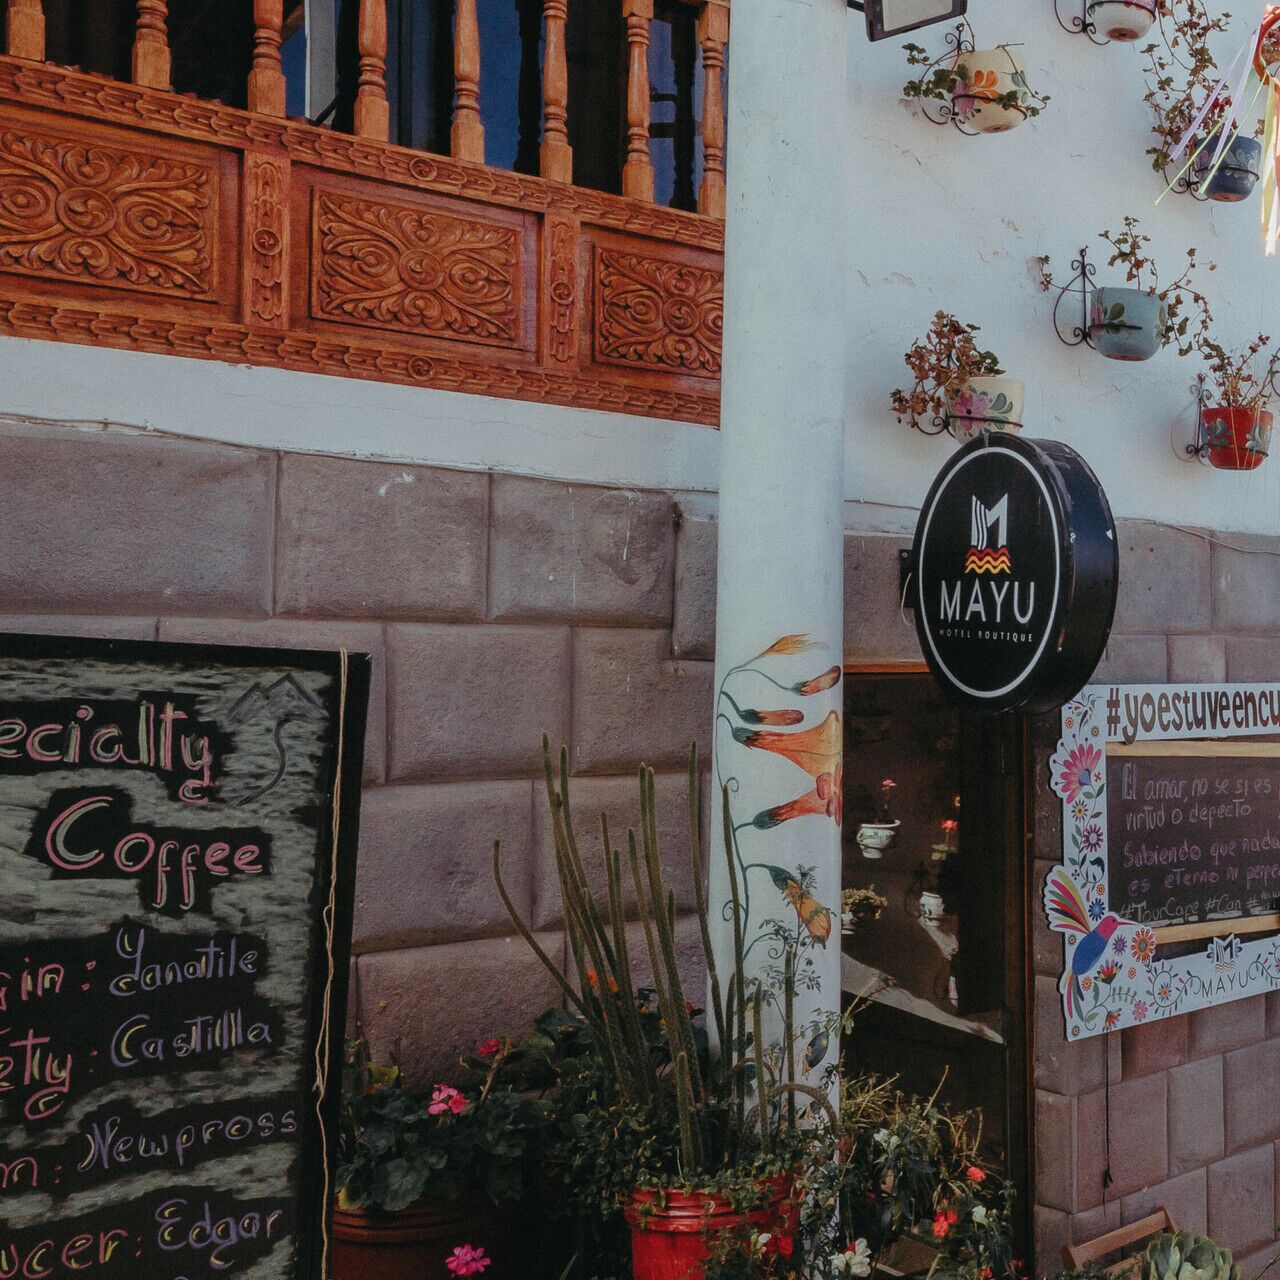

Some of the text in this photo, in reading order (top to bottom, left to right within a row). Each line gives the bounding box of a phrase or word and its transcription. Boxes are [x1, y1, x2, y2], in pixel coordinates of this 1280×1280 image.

[940, 577, 1035, 624] MAYU
[939, 628, 971, 638] HOTEL
[978, 630, 1032, 642] BOUTIQUE
[1122, 761, 1138, 801] El
[1214, 776, 1230, 795] se
[1254, 776, 1272, 794] es
[1171, 808, 1183, 825] o
[46, 795, 263, 909] Coffee
[1123, 838, 1201, 868] Sabiendo
[1210, 841, 1236, 866] que
[1128, 878, 1150, 897] es
[1201, 969, 1249, 998] MAYU
[155, 1198, 283, 1269] Edgar
